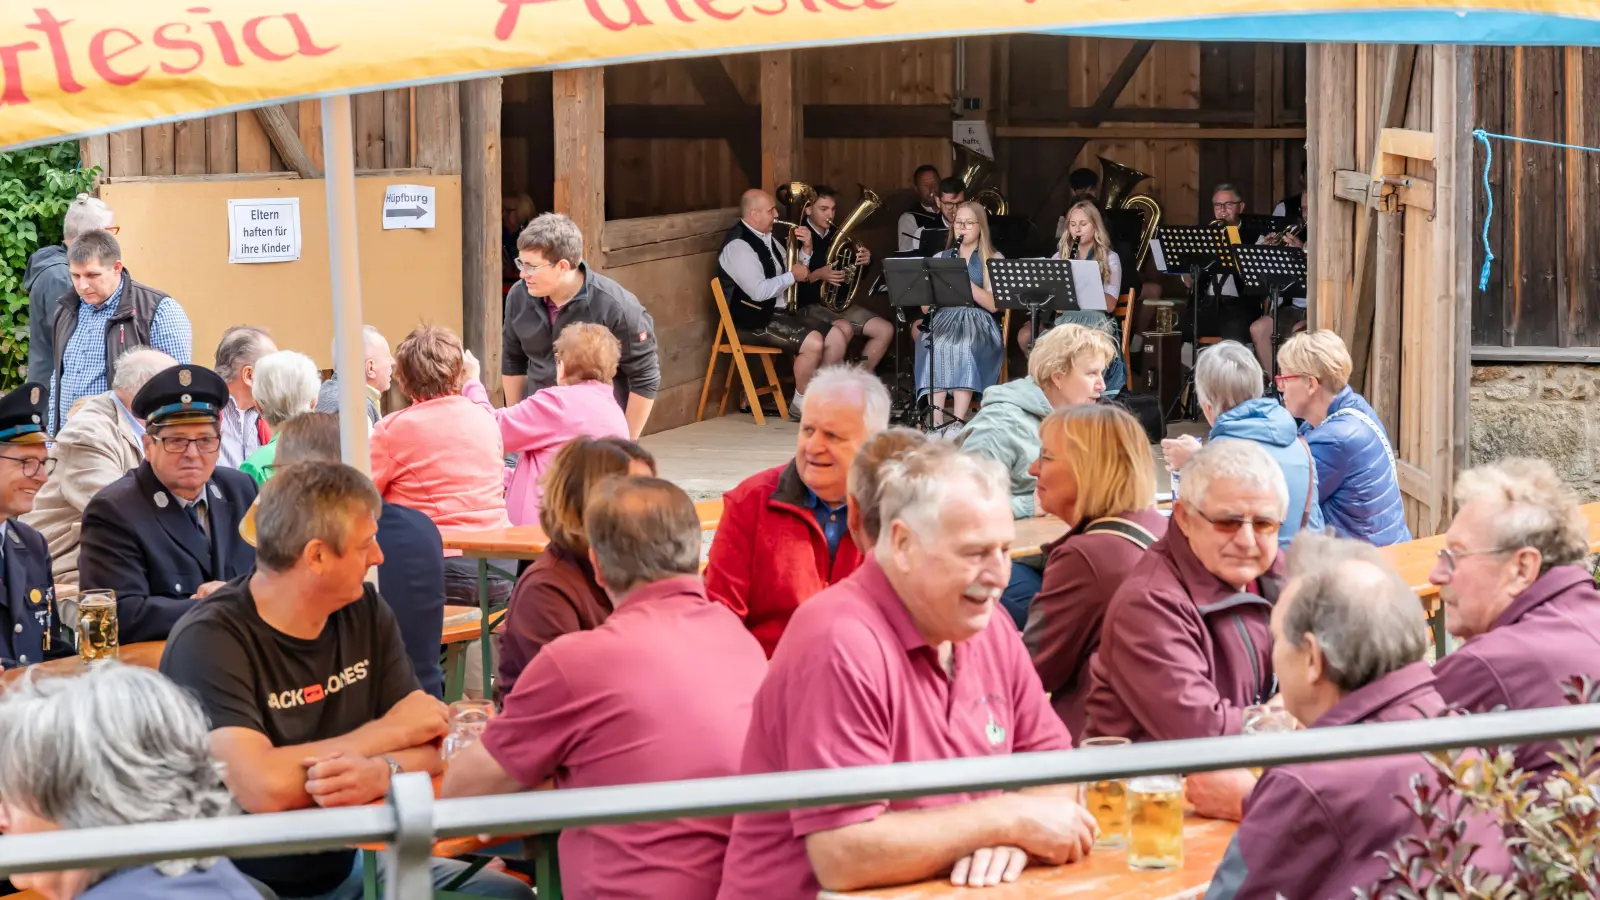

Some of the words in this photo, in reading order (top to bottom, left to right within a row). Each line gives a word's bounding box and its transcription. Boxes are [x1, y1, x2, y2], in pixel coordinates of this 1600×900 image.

[386, 193, 428, 205] Hüpfburg
[251, 209, 279, 220] Eltern
[243, 227, 273, 237] haften
[275, 226, 287, 236] für
[241, 243, 259, 254] ihre
[261, 242, 291, 253] Kinder
[267, 688, 305, 709] ACK
